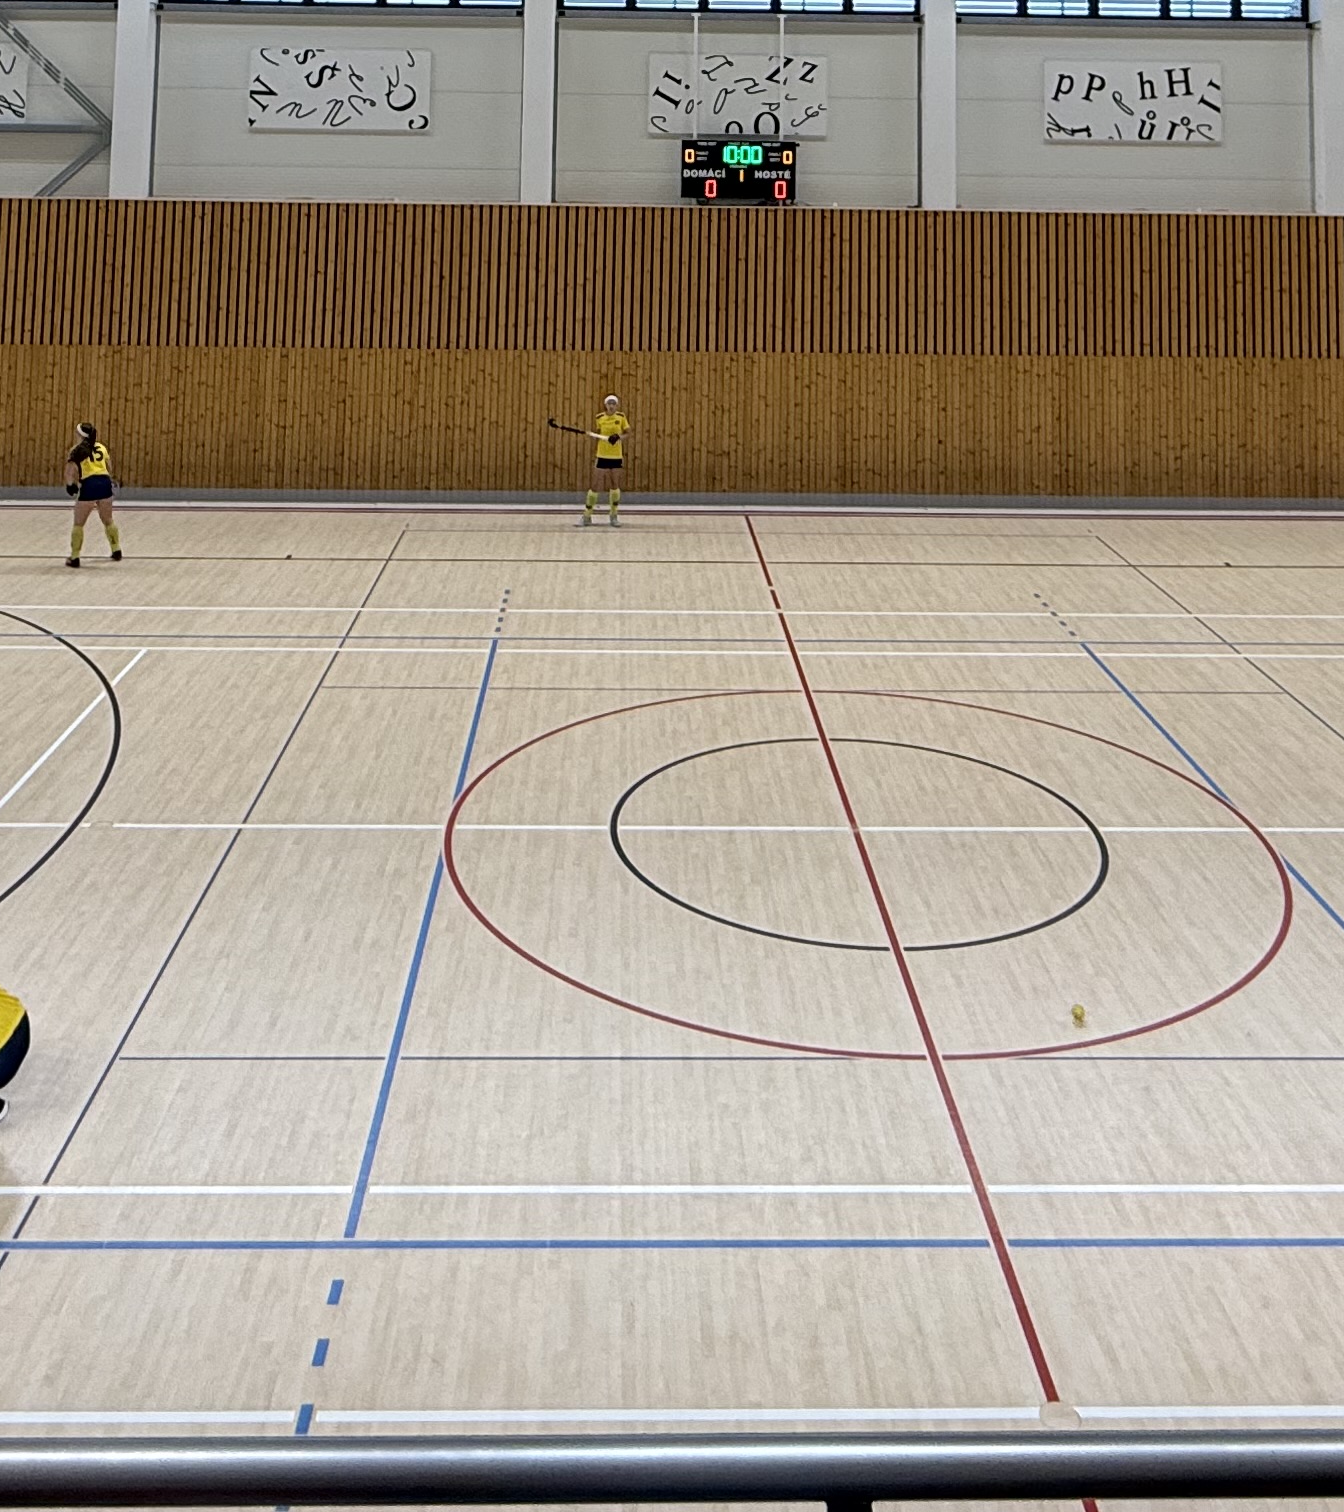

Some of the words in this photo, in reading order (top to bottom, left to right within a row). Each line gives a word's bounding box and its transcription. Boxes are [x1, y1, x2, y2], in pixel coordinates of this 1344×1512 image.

[1137, 71, 1157, 100] h
[1164, 67, 1194, 97] H
[684, 148, 695, 163] 0
[723, 145, 763, 165] 10:00
[782, 150, 793, 165] 0
[683, 168, 726, 178] DOMÁCÍ
[754, 169, 792, 179] HOSTÉ
[705, 179, 717, 198] 0
[774, 180, 787, 199] 0
